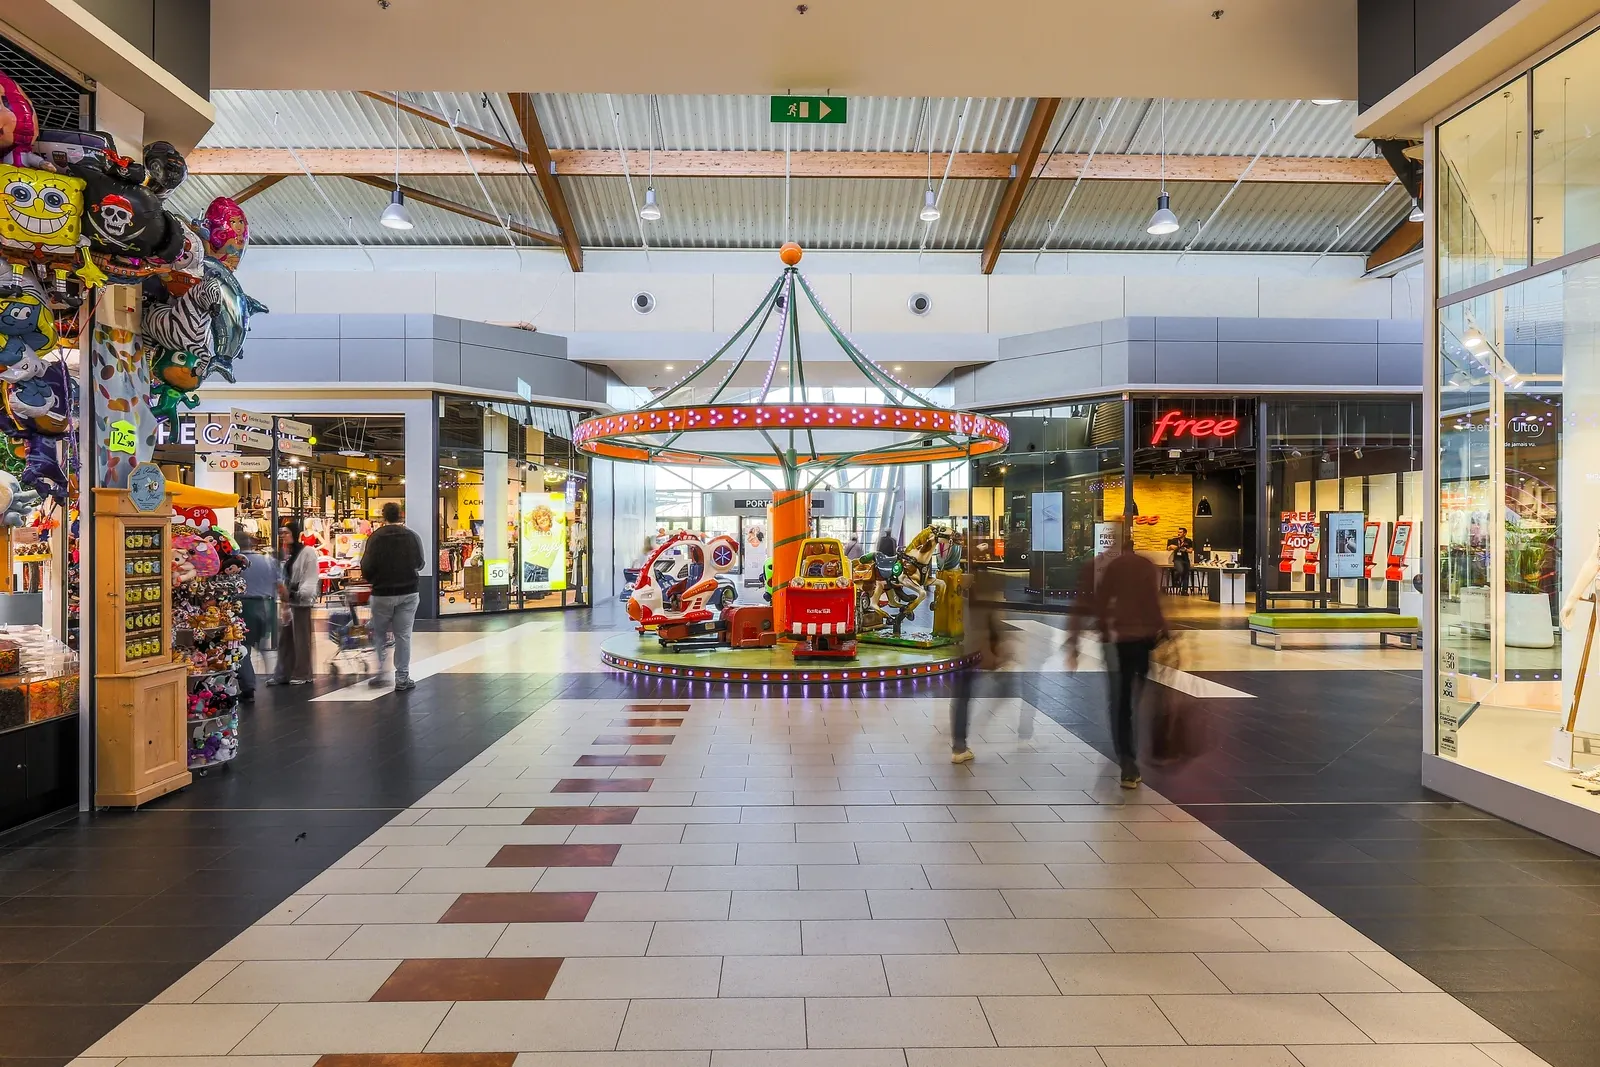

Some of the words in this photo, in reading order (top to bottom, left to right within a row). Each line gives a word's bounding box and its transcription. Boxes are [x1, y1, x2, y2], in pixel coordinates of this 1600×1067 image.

[1151, 411, 1238, 444] free
[1281, 512, 1316, 522] FREE
[1281, 522, 1315, 533] DAYS
[1281, 537, 1315, 548] -400€
[1445, 652, 1455, 661] 36
[1444, 681, 1453, 689] XS
[1442, 690, 1455, 698] XXL
